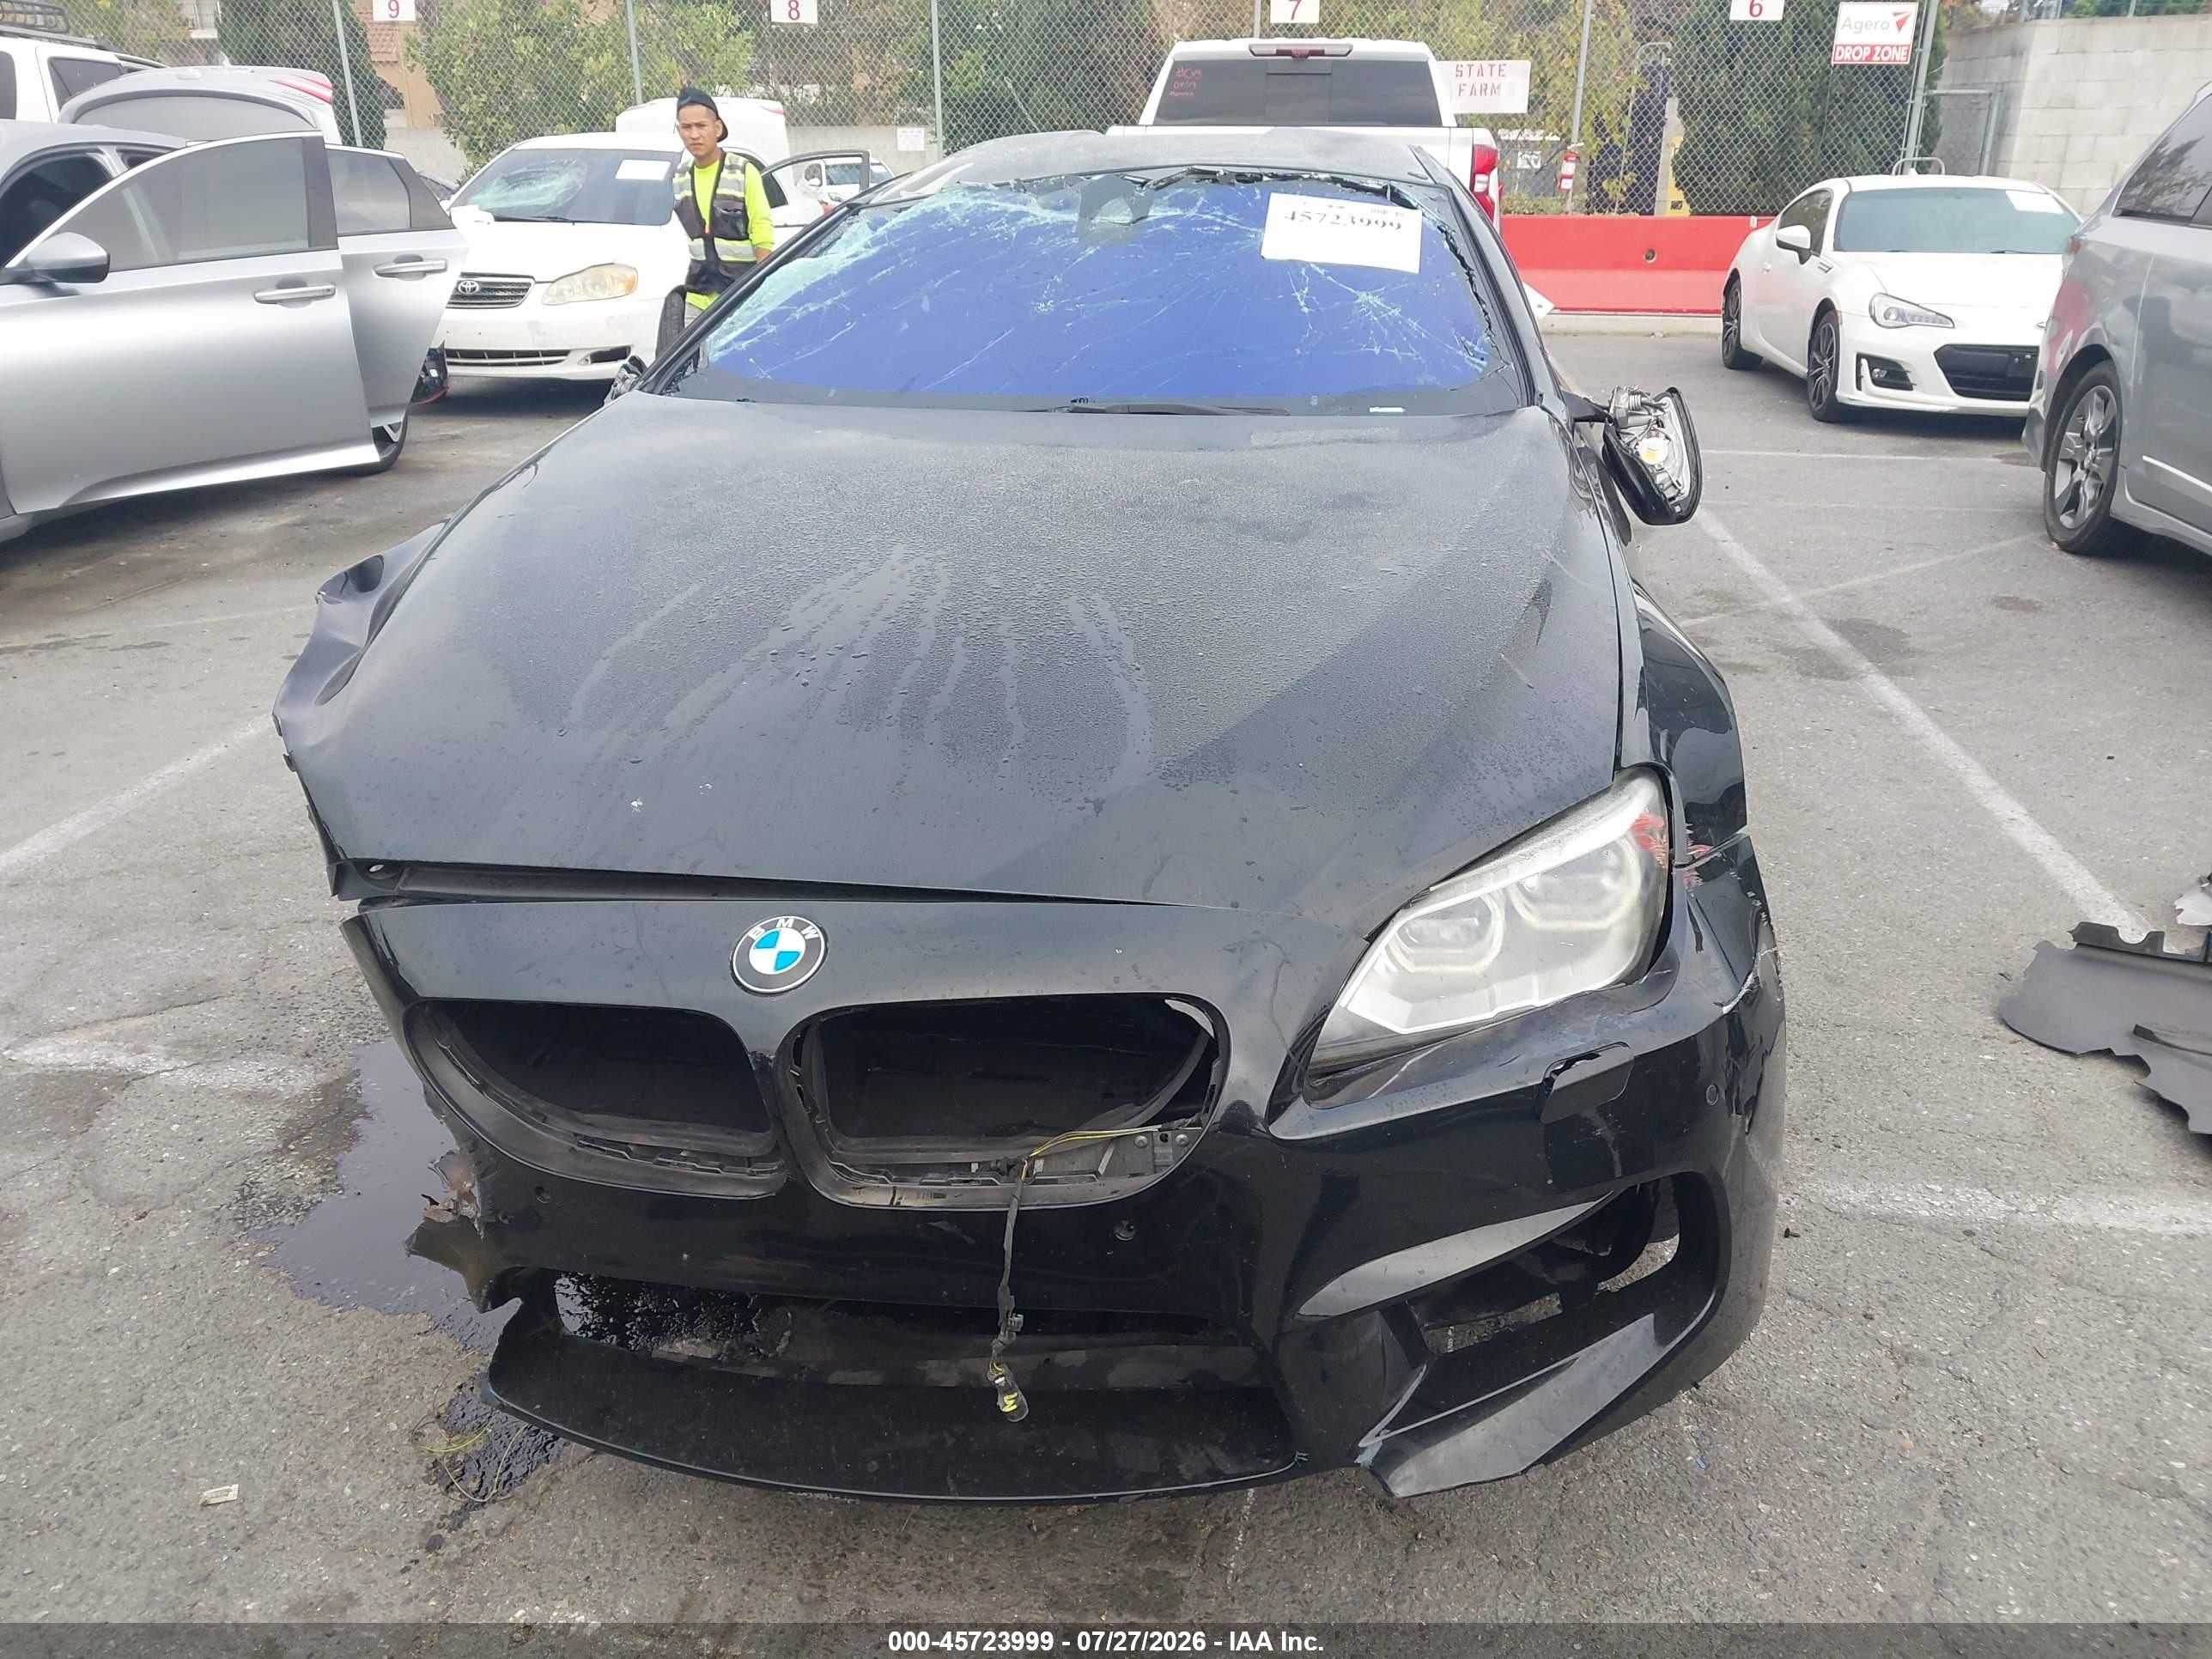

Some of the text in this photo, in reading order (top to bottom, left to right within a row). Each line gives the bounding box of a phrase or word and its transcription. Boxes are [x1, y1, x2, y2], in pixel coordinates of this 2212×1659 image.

[388, 0, 399, 19] 9
[788, 0, 800, 21] 8
[1289, 0, 1302, 21] 7
[1749, 0, 1763, 18] 6
[1840, 16, 1890, 33] Agero
[1834, 46, 1908, 61] DROP ZONE
[1455, 64, 1507, 78] STATE
[1458, 82, 1501, 96] FARM
[748, 918, 820, 940] BMW
